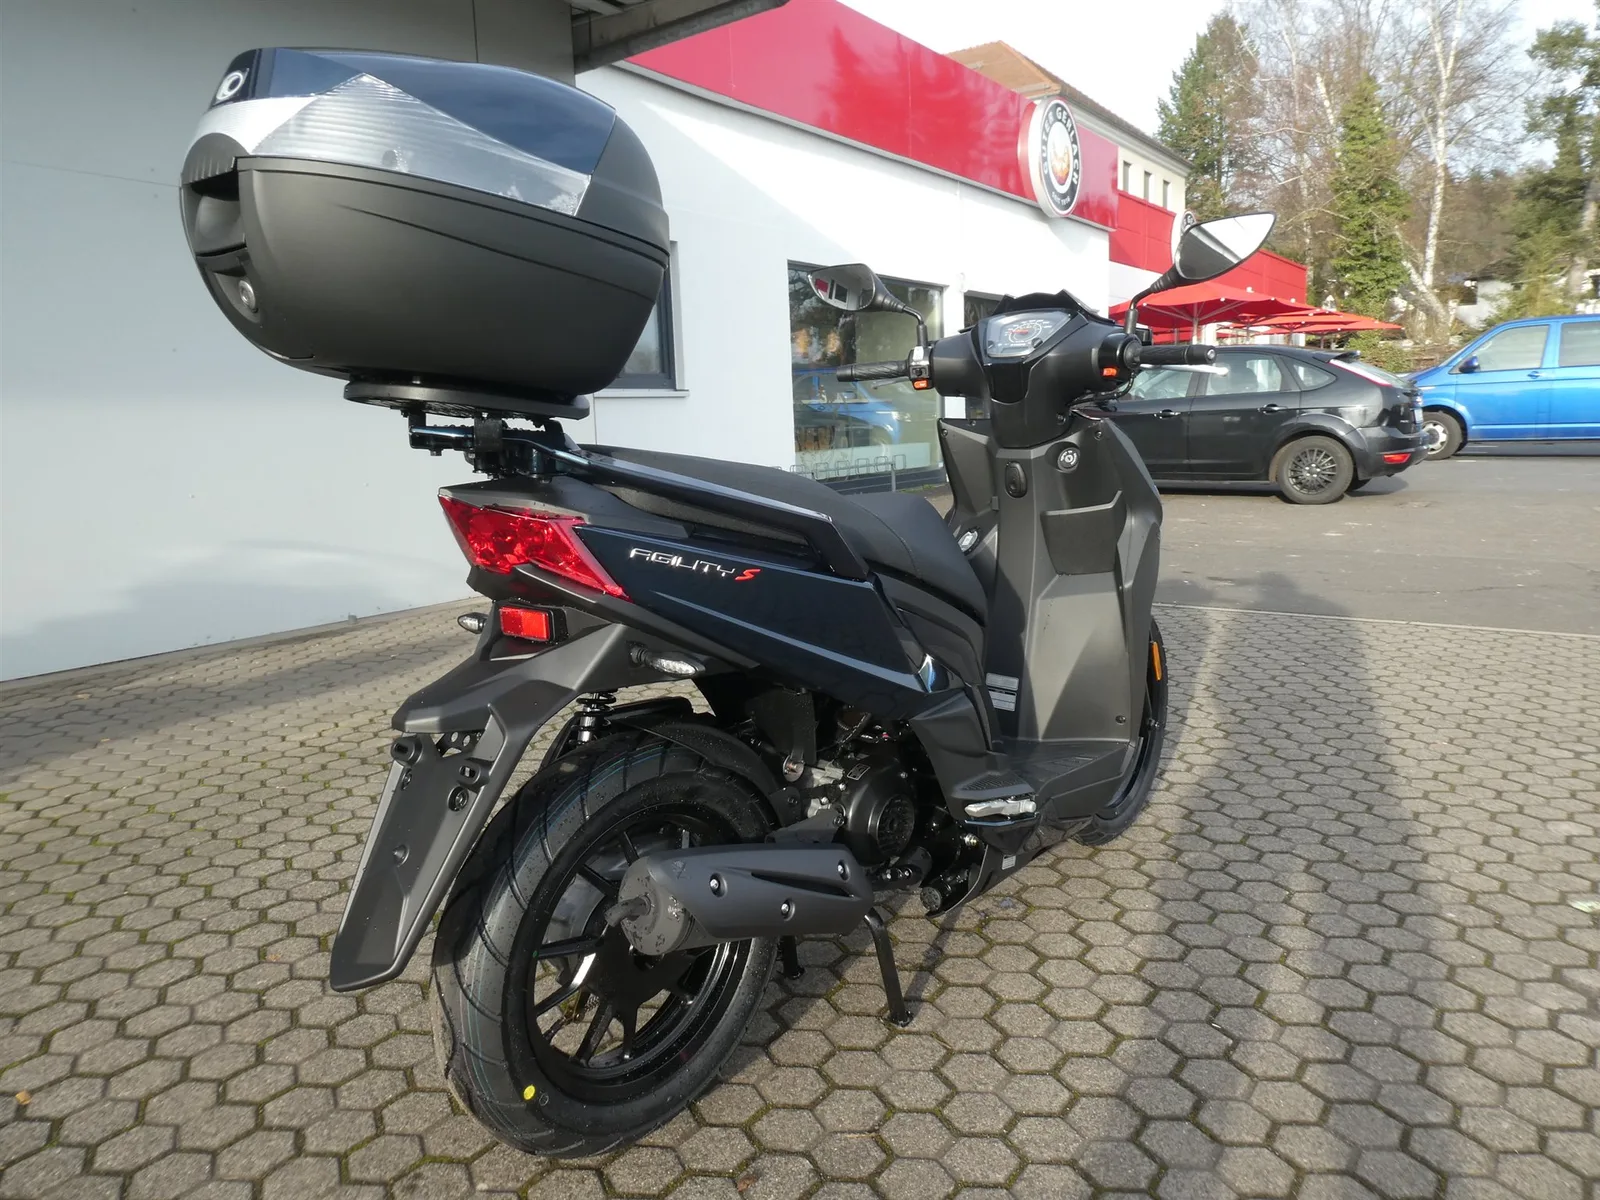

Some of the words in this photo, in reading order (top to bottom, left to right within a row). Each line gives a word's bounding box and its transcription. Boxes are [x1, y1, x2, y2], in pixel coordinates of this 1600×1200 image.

[1055, 106, 1079, 185] GERLACH
[629, 547, 736, 577] AGILITY
[734, 568, 761, 580] S
